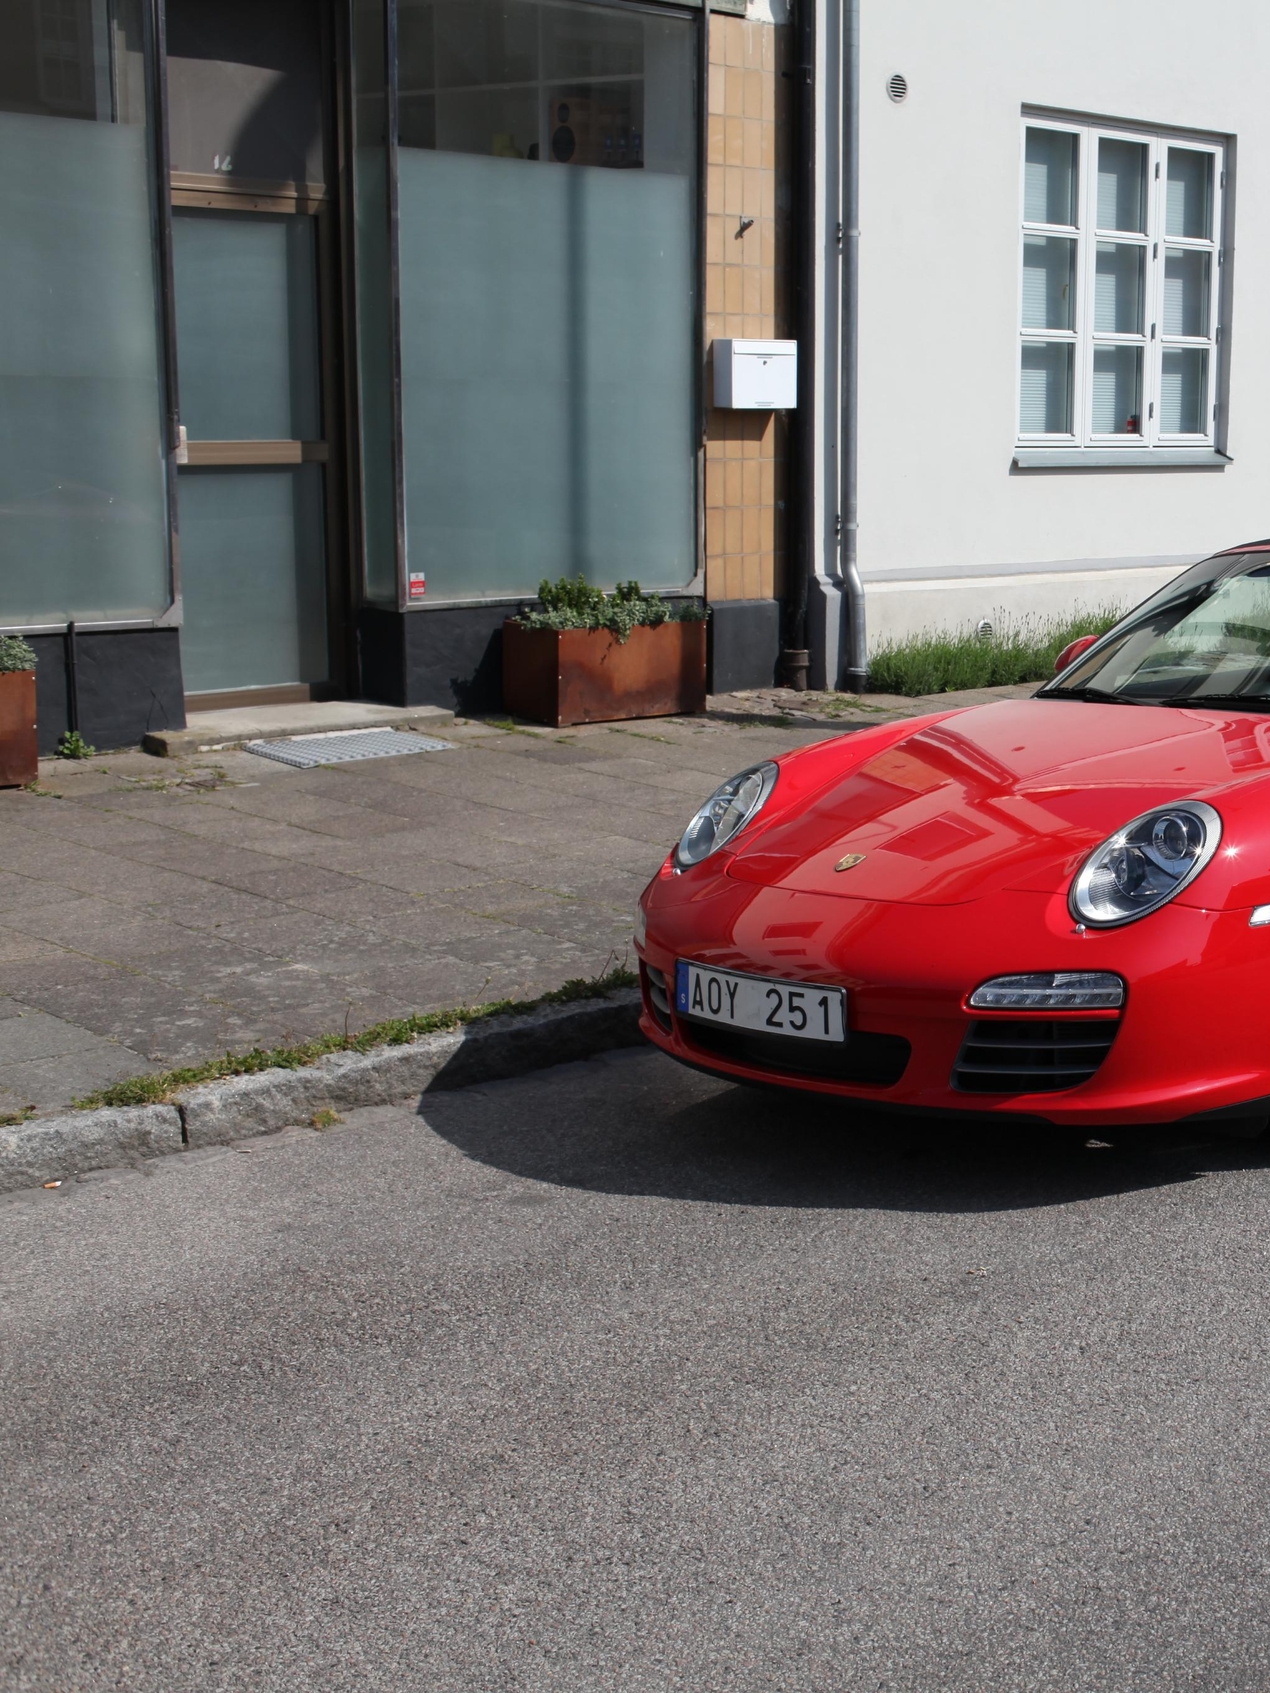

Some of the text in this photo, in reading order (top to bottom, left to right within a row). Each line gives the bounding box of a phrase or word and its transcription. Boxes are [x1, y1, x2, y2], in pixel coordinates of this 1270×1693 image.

[214, 154, 232, 171] 16
[681, 993, 686, 1004] S
[692, 973, 829, 1035] AOY 251
